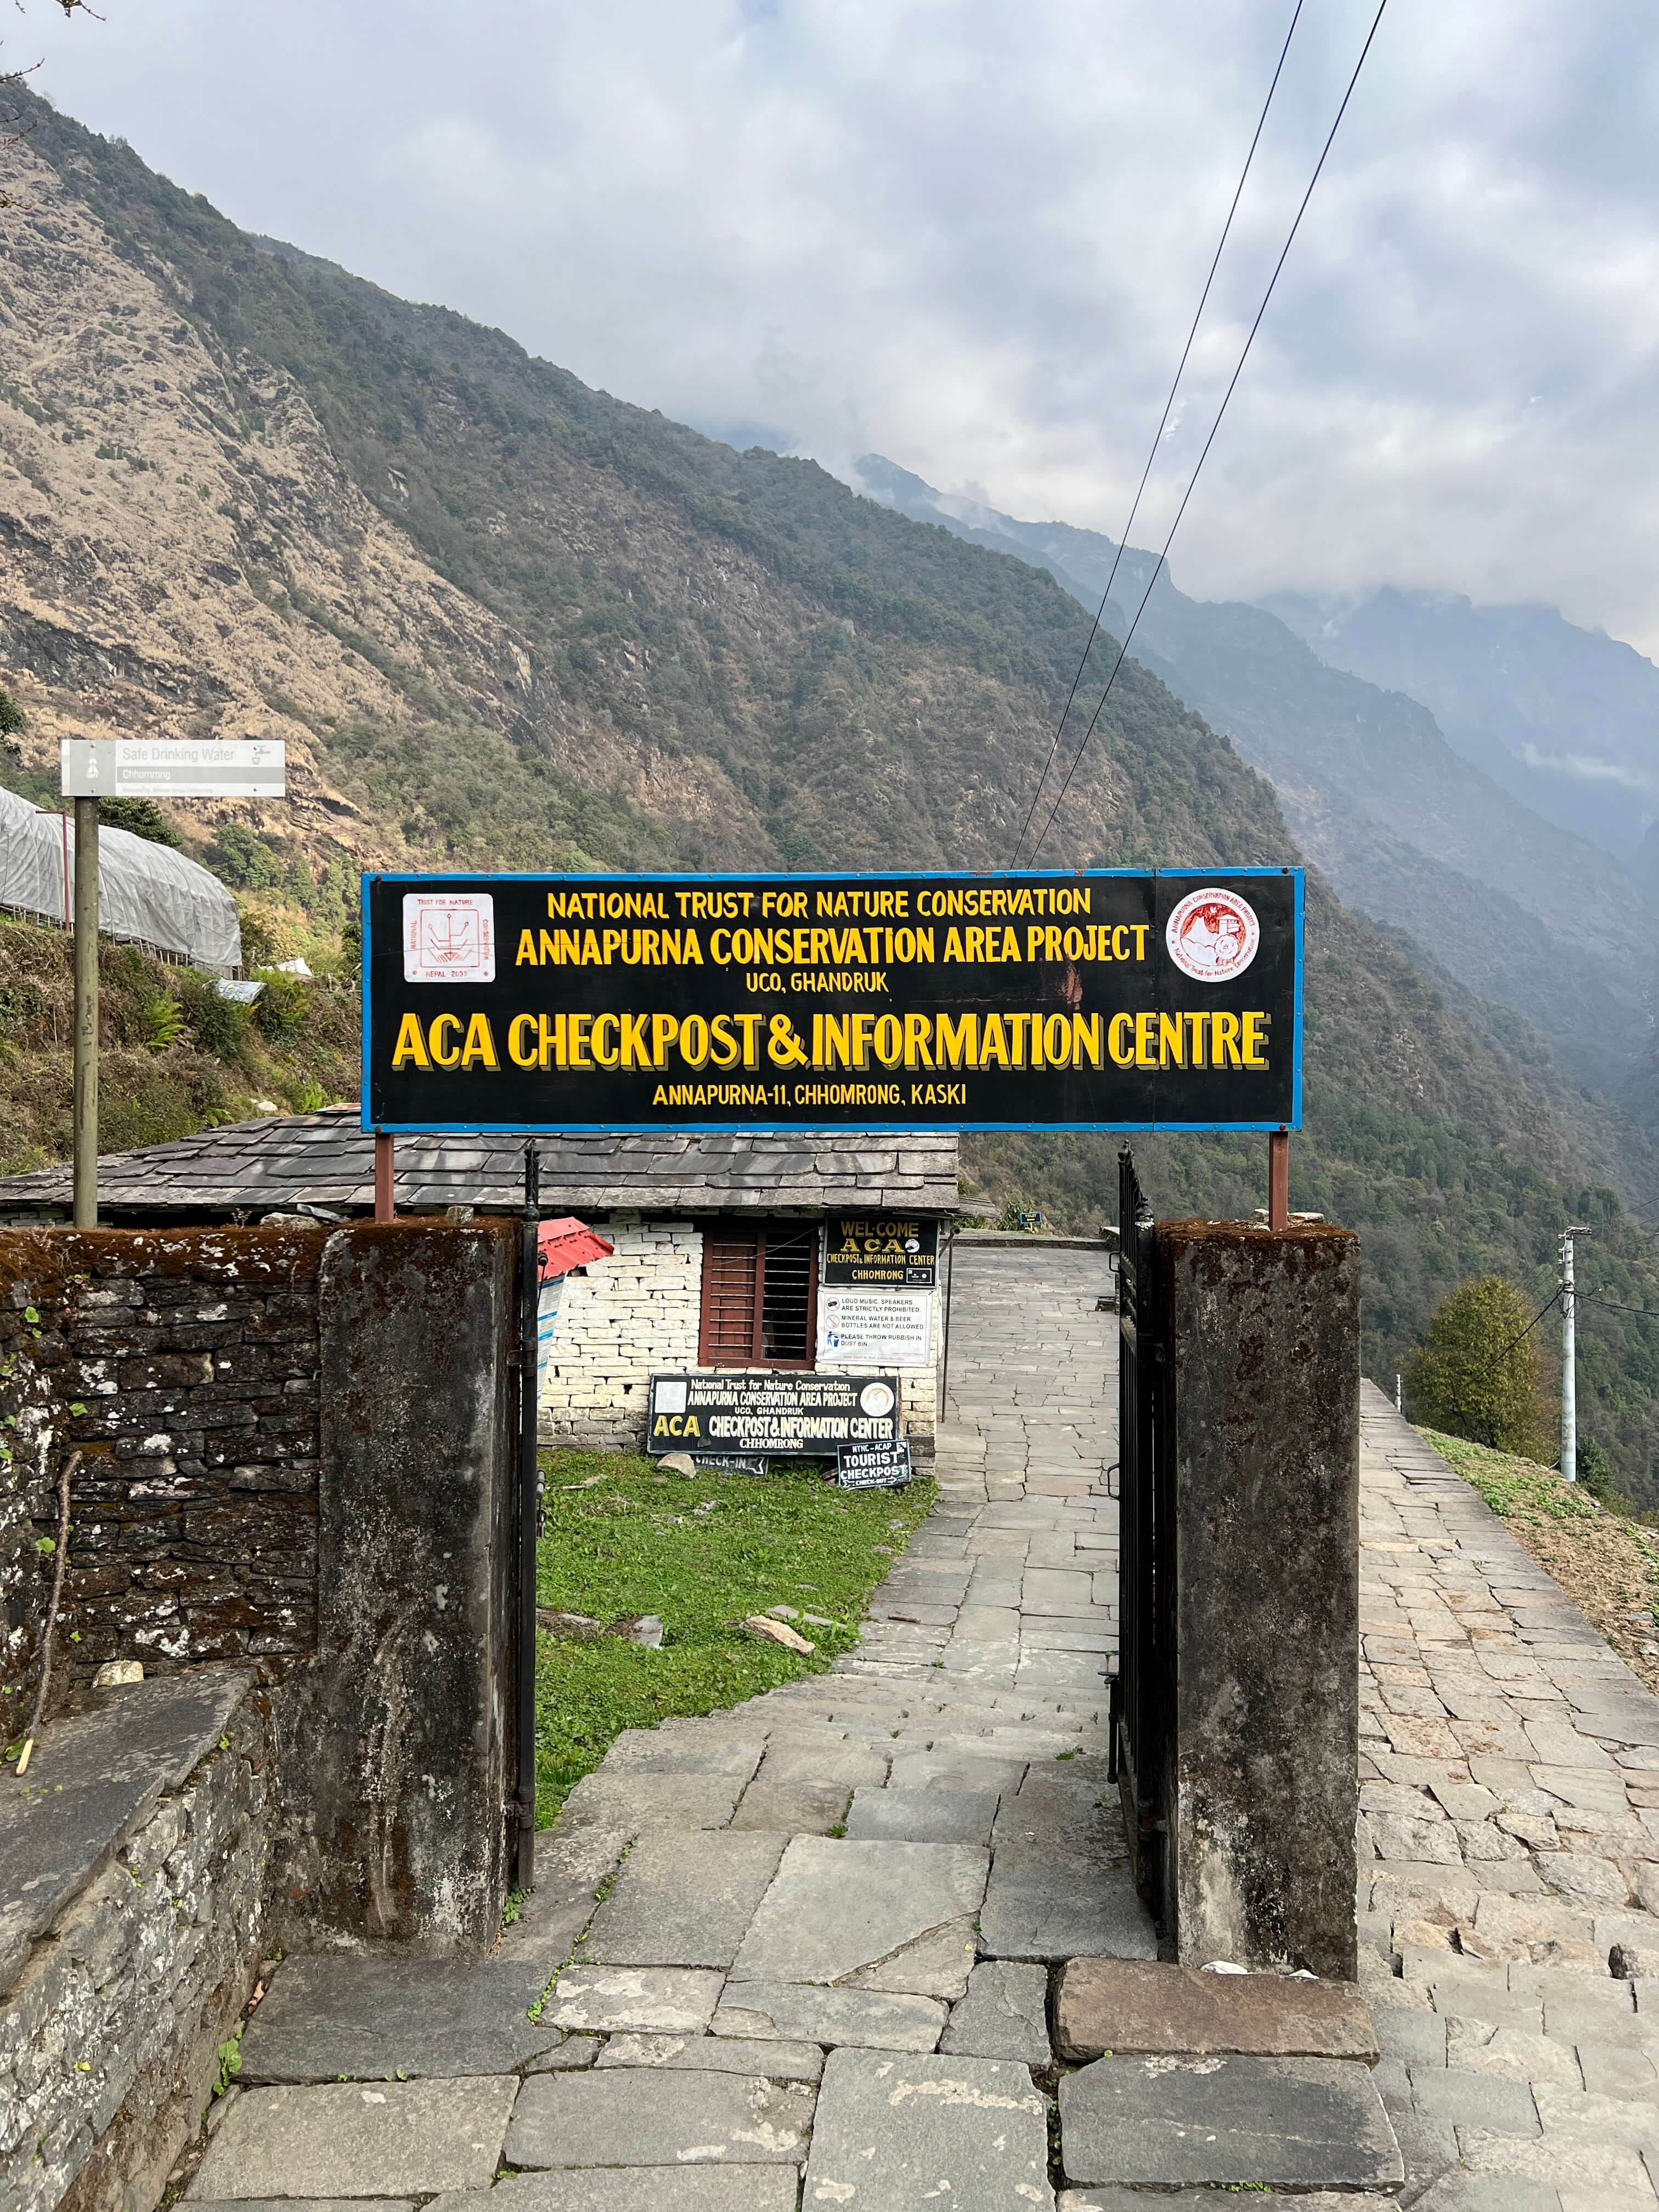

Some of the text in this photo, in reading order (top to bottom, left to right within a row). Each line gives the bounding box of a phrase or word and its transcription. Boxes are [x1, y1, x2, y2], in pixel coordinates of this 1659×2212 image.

[123, 748, 235, 762] Safe Drinking Water
[123, 769, 171, 780] Chhomrong
[548, 888, 1091, 919] NATIONAL TRUST FOR NATURE CONSERVATION
[1171, 892, 1255, 933] ANNAPURNA CONSERVATION AREA PROJECT
[515, 924, 1150, 966] ANNAPURNA CONSERVATION AREA PROJECT
[1173, 948, 1190, 969] National
[1191, 965, 1204, 975] Trust
[1215, 967, 1234, 976] Nature
[1234, 939, 1255, 968] Conservation
[746, 972, 889, 994] UCO, GHANDRUK
[392, 1013, 500, 1069] ACA
[507, 1013, 766, 1069] CHECKPOST
[812, 1013, 1102, 1068] INFORMATION
[1107, 1011, 1268, 1067] CENTRE
[652, 1084, 967, 1107] ANNAPURNA-11, CHHOMRONG, KASKI
[840, 1238, 905, 1254] ACA
[864, 1254, 906, 1265] INFORMATION
[909, 1255, 935, 1266] CENTER
[851, 1269, 904, 1280] CHHOMRONG
[691, 1379, 850, 1391] National Trust for Nature Conservation
[687, 1391, 858, 1407] ANNAPURNA CONSERVATION AREA PROJECT
[734, 1407, 804, 1415] UCO, GHANDRUK
[653, 1415, 701, 1437] ACA
[709, 1415, 771, 1438] CHECKPOST
[780, 1416, 849, 1438] INFORMATION
[850, 1417, 893, 1440] CENTER
[740, 1438, 804, 1449] CHHOMRONG
[695, 1455, 747, 1469] CHECK-IN
[843, 1451, 900, 1468] TOURIST
[840, 1464, 908, 1480] CHECKPOST
[855, 1477, 888, 1486] CHECK-OUT
